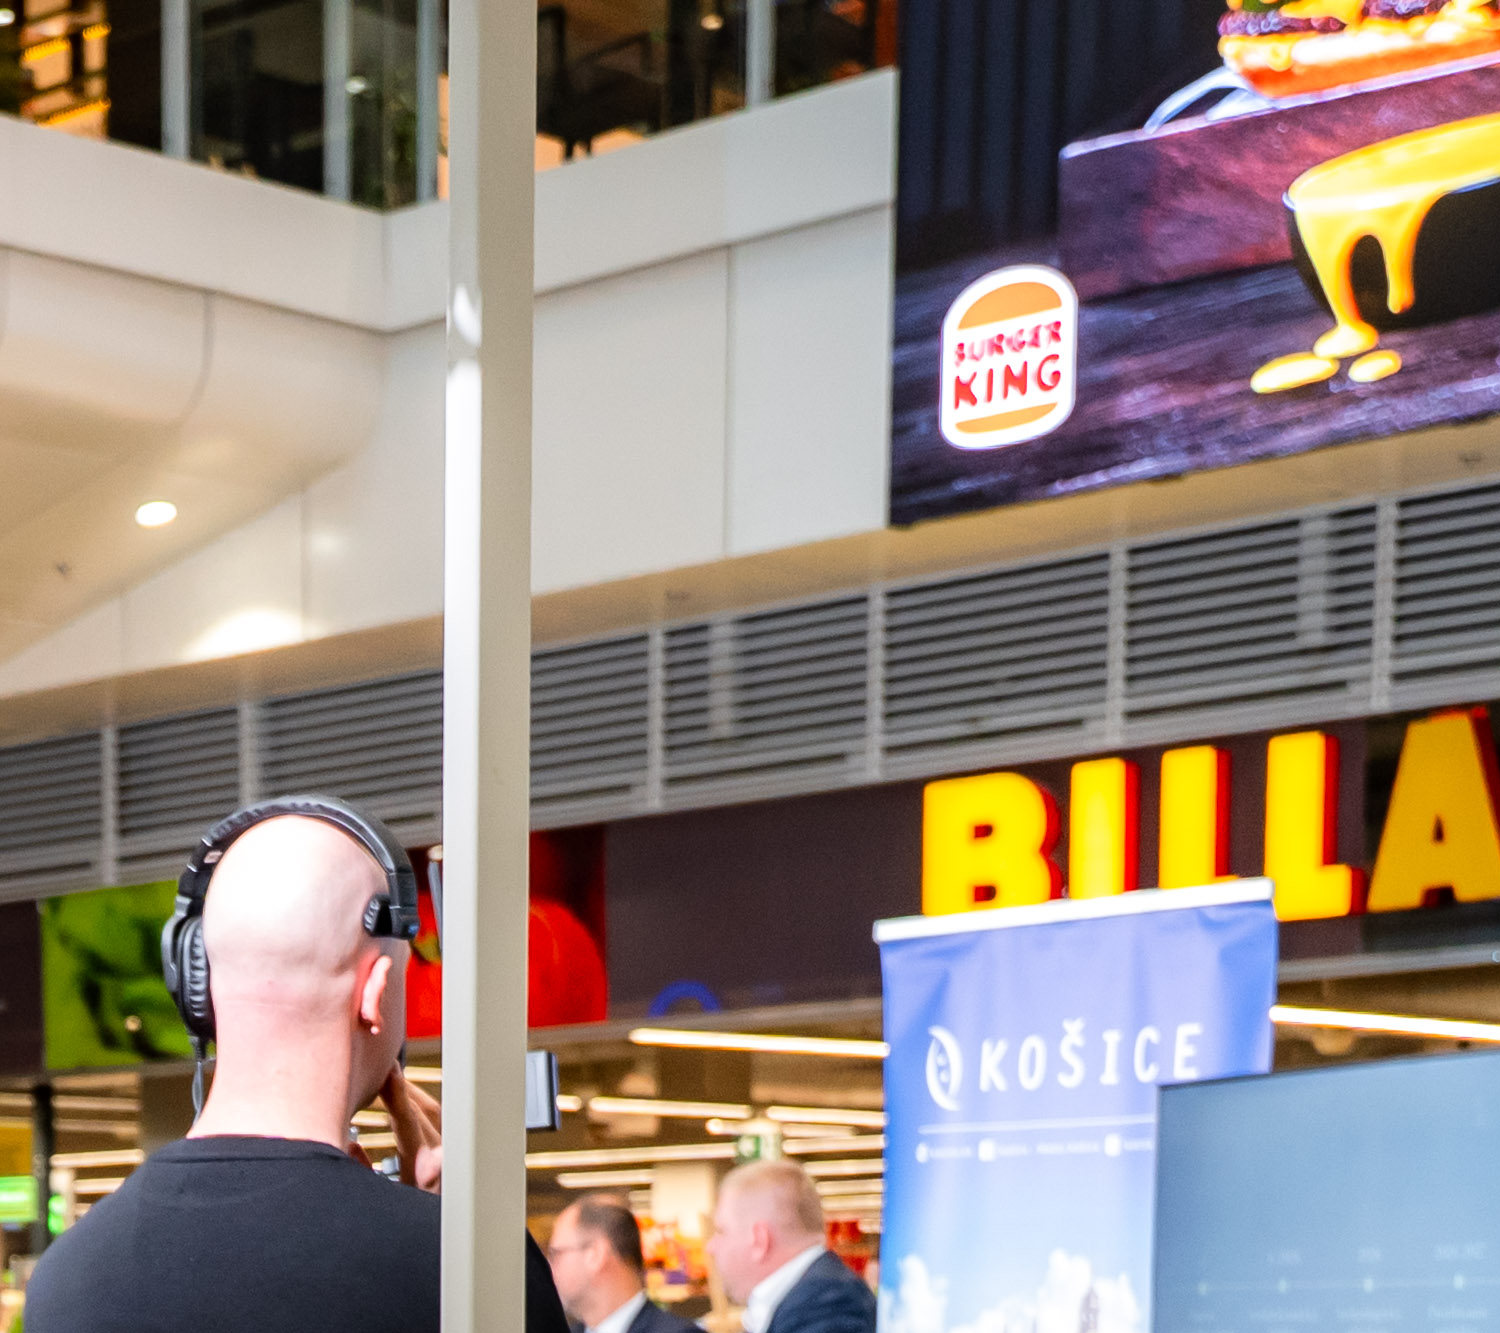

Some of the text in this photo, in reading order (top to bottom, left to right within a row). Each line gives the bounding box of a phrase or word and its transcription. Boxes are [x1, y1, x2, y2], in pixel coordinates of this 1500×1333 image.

[955, 320, 1062, 367] BURGER
[954, 353, 1061, 410] KING
[979, 1017, 1204, 1092] KOŠICE
